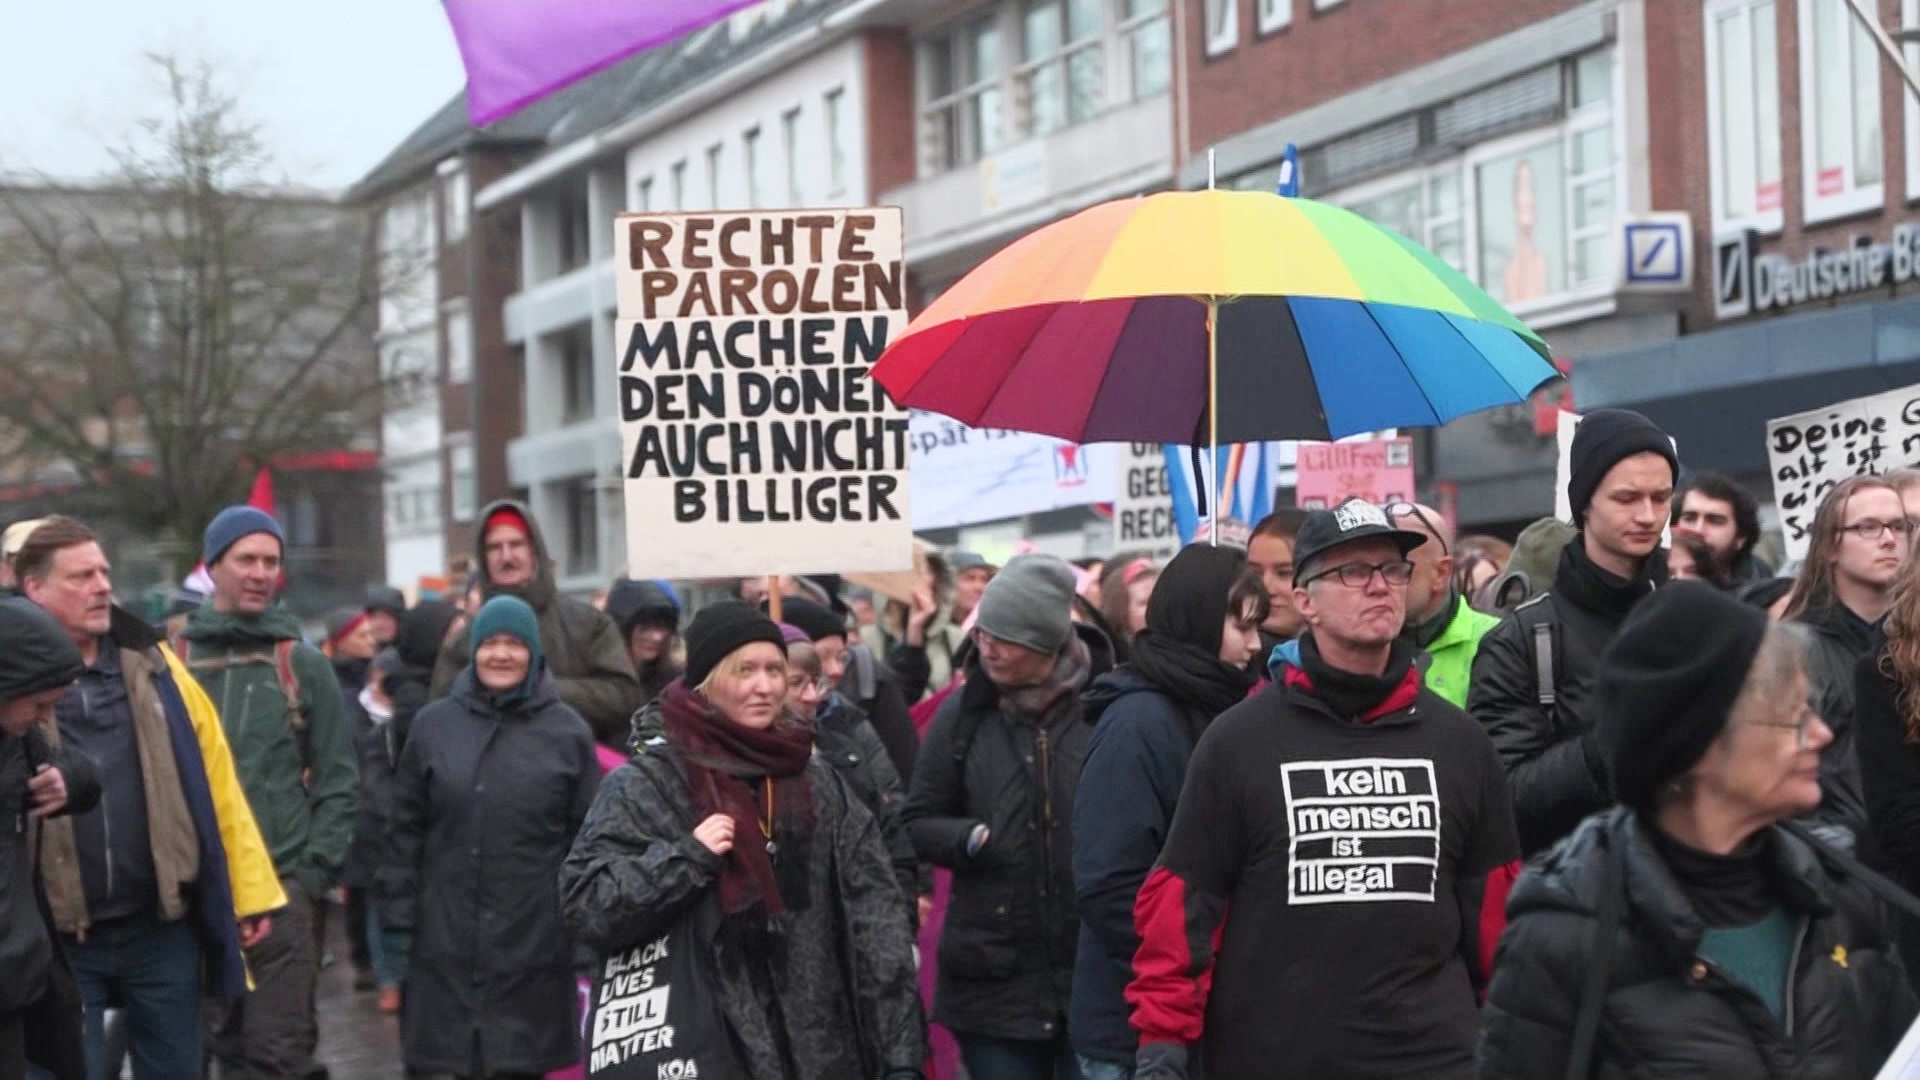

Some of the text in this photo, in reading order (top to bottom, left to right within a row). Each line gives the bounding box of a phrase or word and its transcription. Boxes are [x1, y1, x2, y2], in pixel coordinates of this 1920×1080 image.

[629, 215, 876, 270] RECHTE
[642, 261, 902, 319] PAROLEN
[1755, 239, 1884, 310] Deutsche
[620, 316, 888, 371] MACHEN
[620, 372, 726, 421] DEN
[628, 417, 909, 478] AUCH NICHT
[1773, 413, 1887, 454] Deine
[1777, 454, 1828, 482] alt
[674, 475, 901, 522] BILLIGER
[1325, 766, 1407, 796] kein
[1297, 801, 1432, 832] mensch
[1332, 835, 1363, 857] ist
[1300, 863, 1394, 895] illegal
[590, 1025, 675, 1075] MATTER
